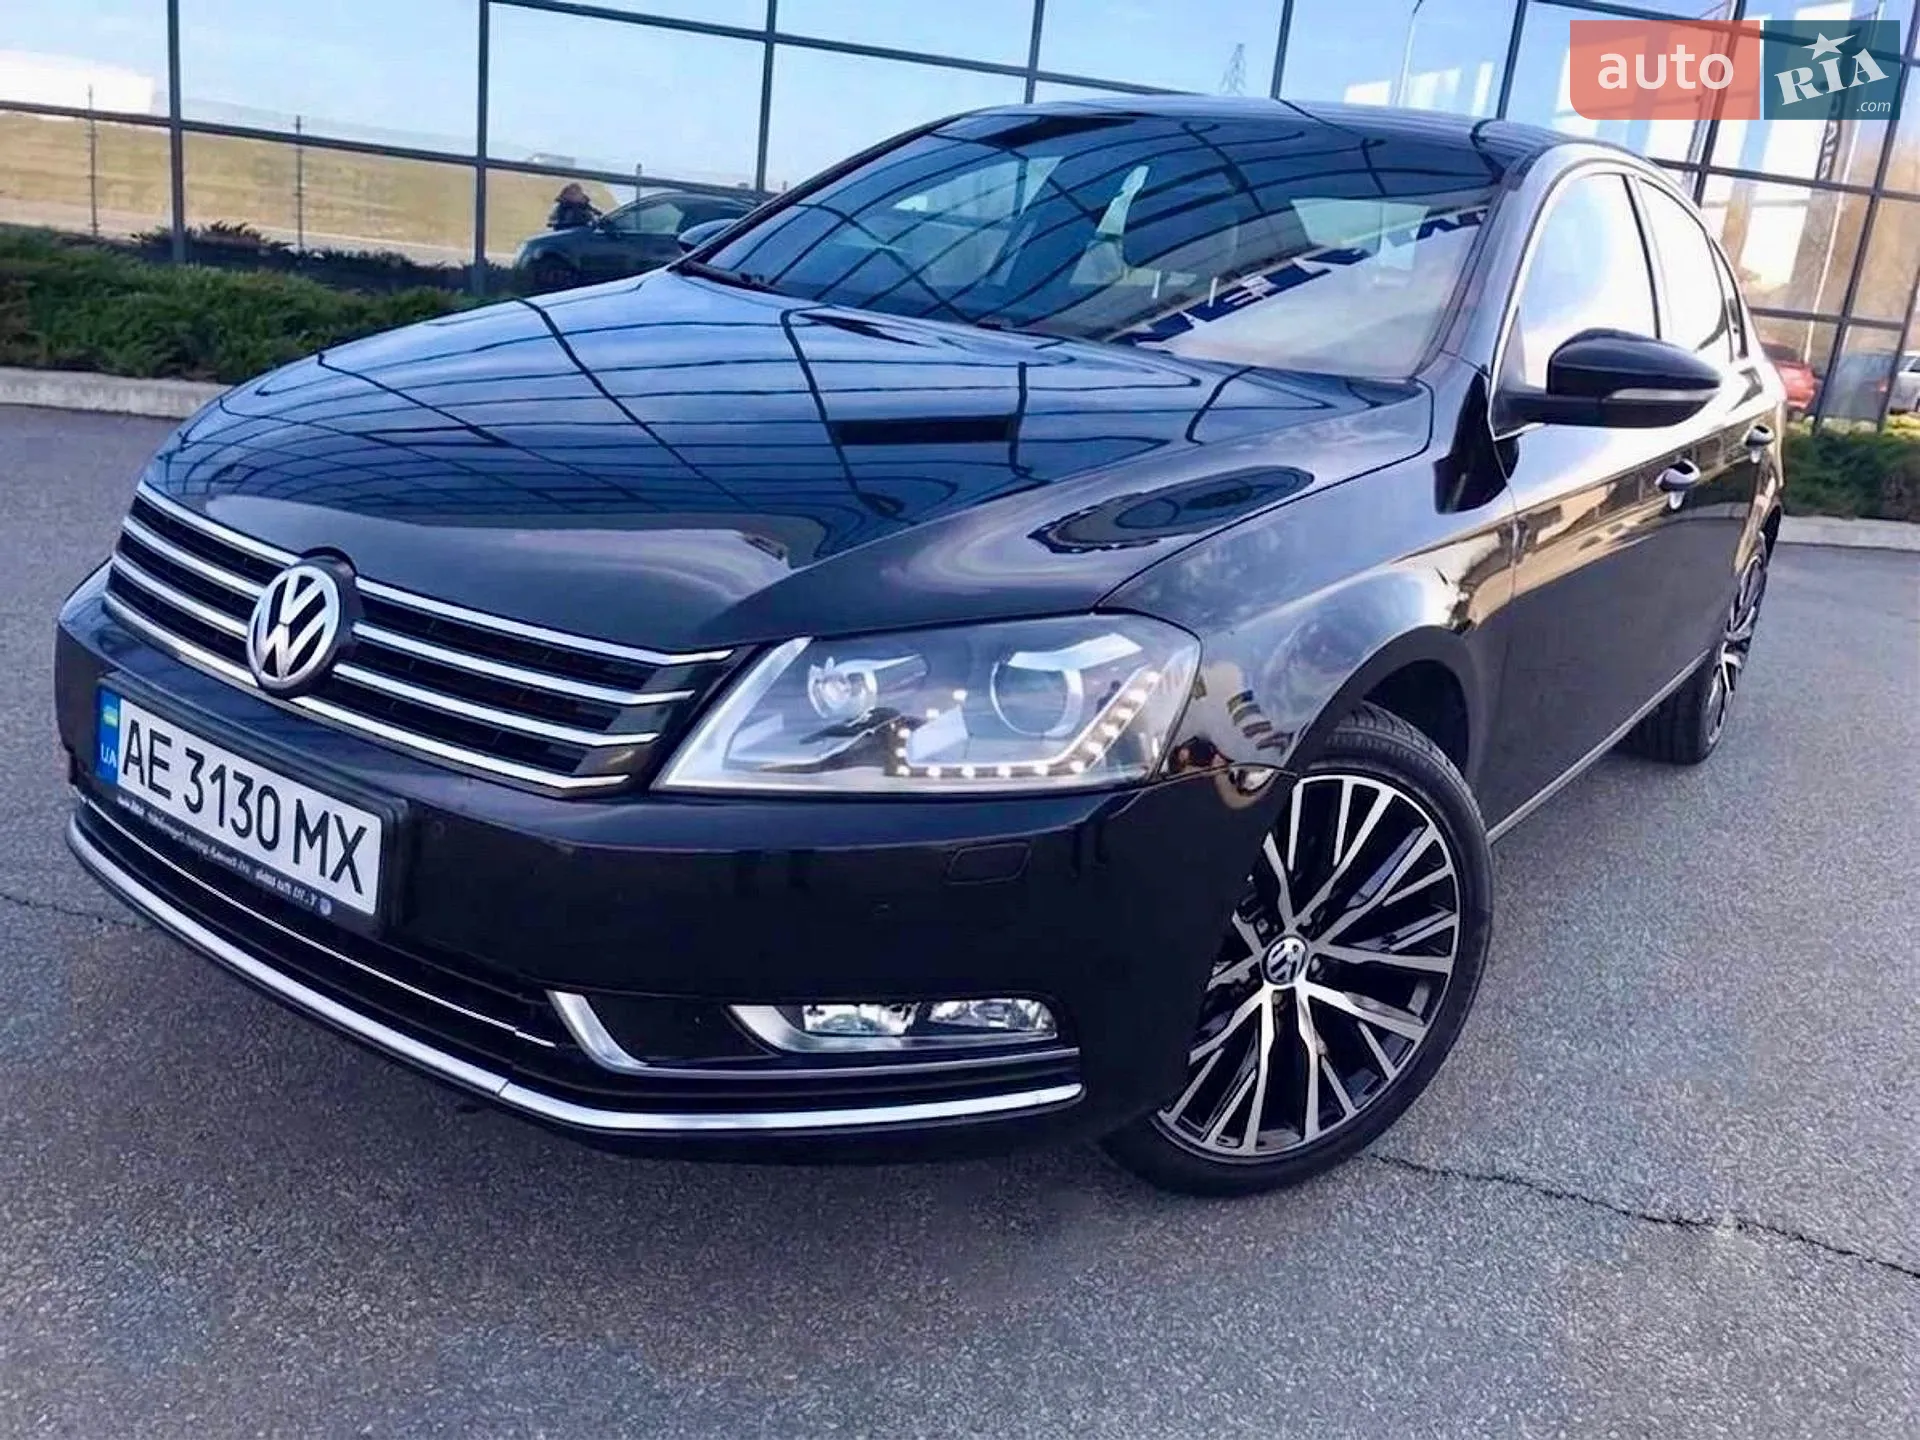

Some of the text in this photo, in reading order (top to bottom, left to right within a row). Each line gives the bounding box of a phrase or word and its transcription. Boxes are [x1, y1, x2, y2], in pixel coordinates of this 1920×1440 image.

[101, 743, 117, 769] UA
[122, 719, 173, 801] AE
[184, 747, 281, 852] 3130
[293, 798, 368, 896] MX
